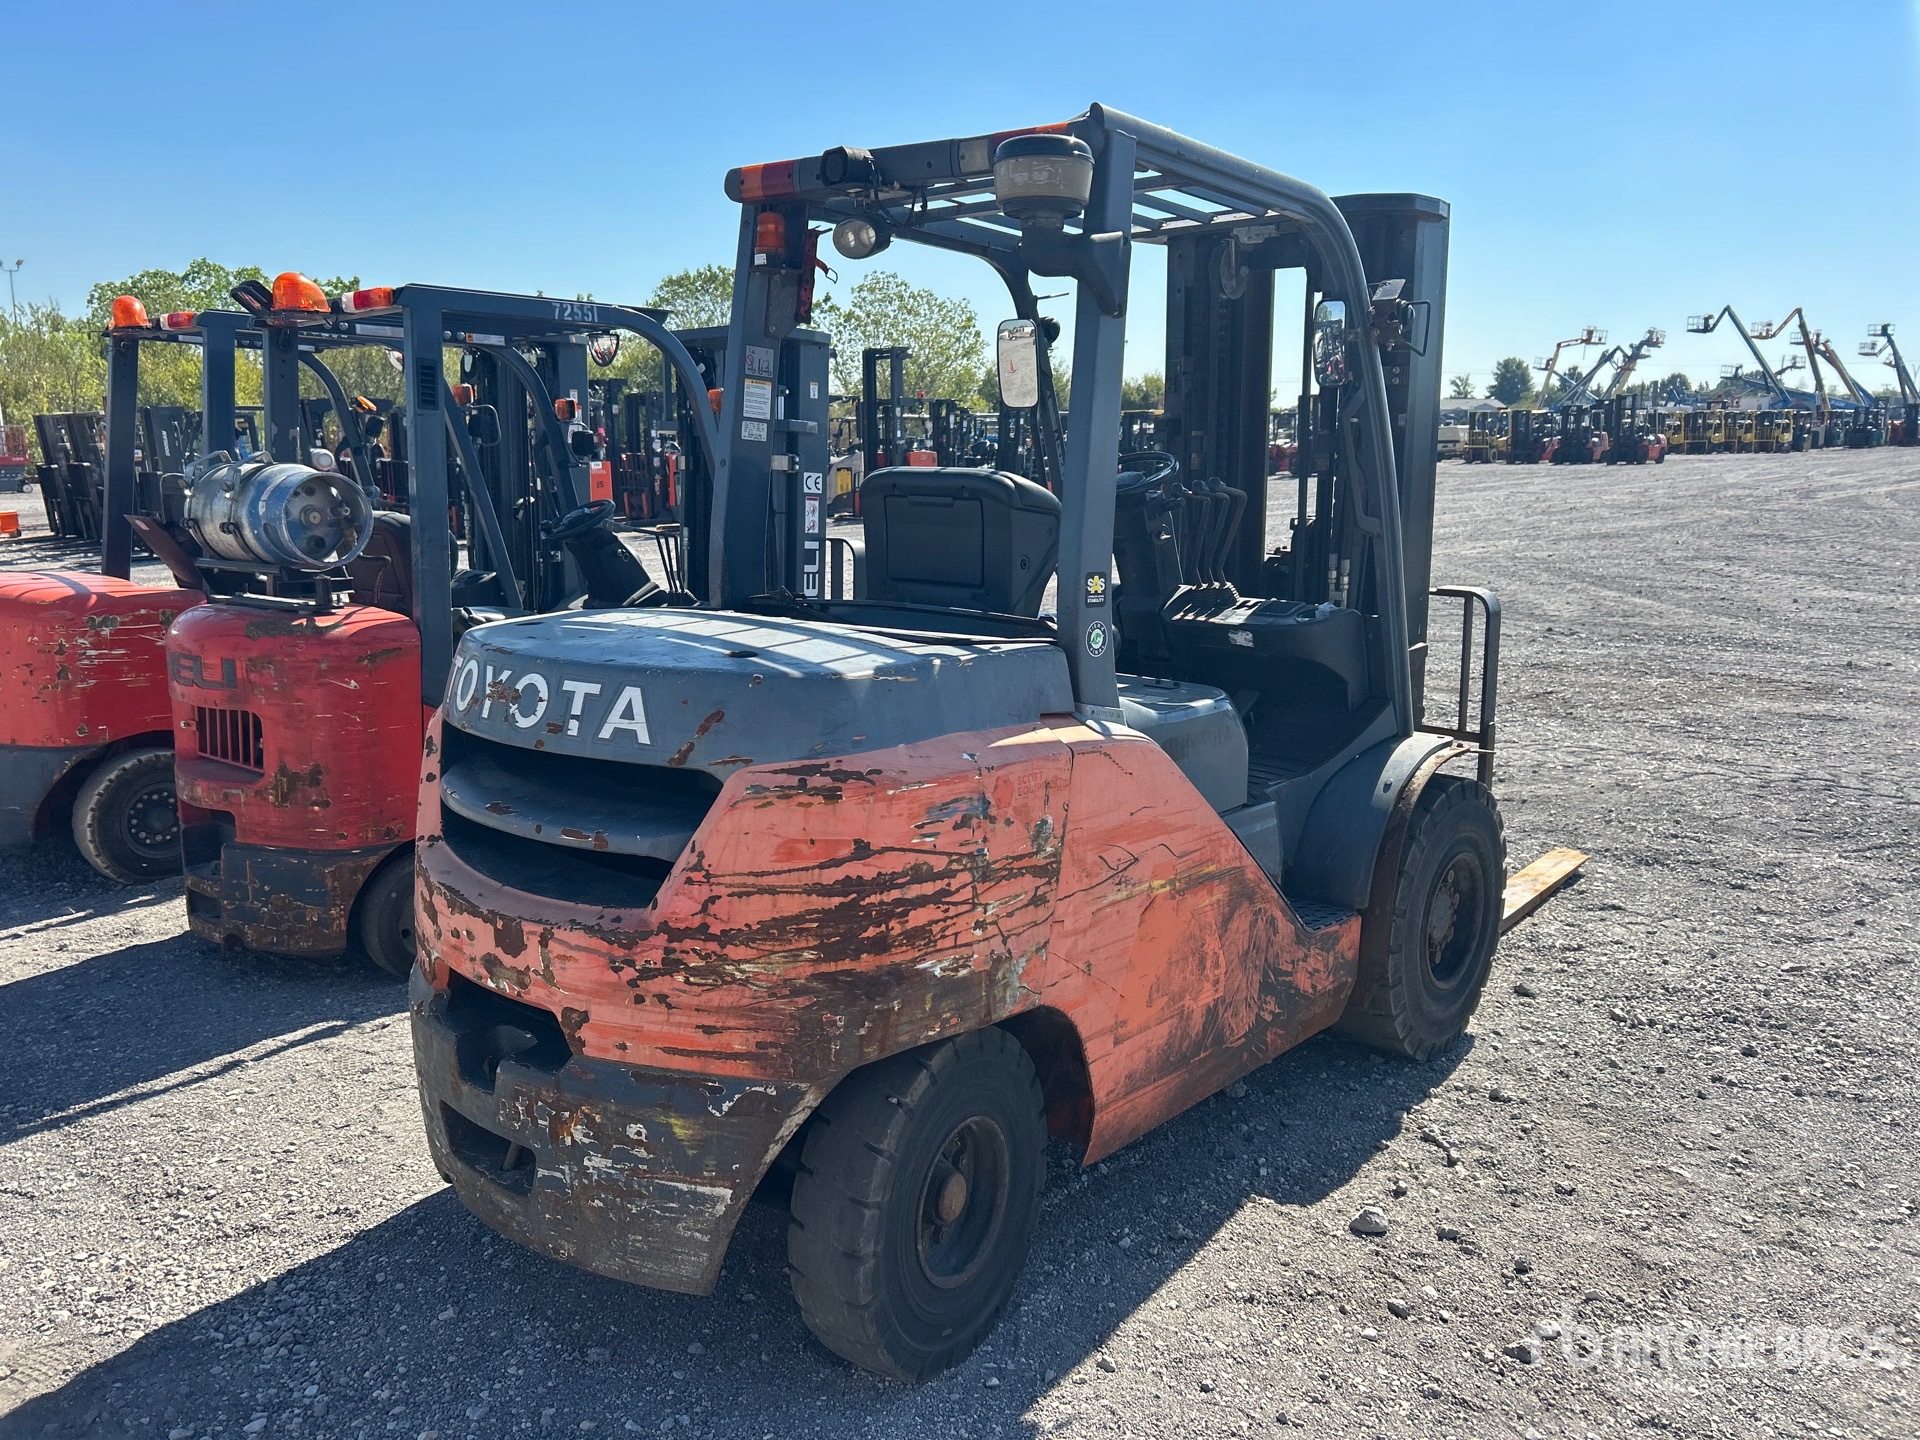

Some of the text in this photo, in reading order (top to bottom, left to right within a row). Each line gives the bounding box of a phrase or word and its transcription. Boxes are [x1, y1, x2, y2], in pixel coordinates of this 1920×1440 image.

[552, 302, 598, 323] 72551
[805, 475, 821, 491] CE
[803, 540, 820, 600] ELI
[1087, 575, 1105, 593] SAS
[446, 655, 651, 745] TOYOTA
